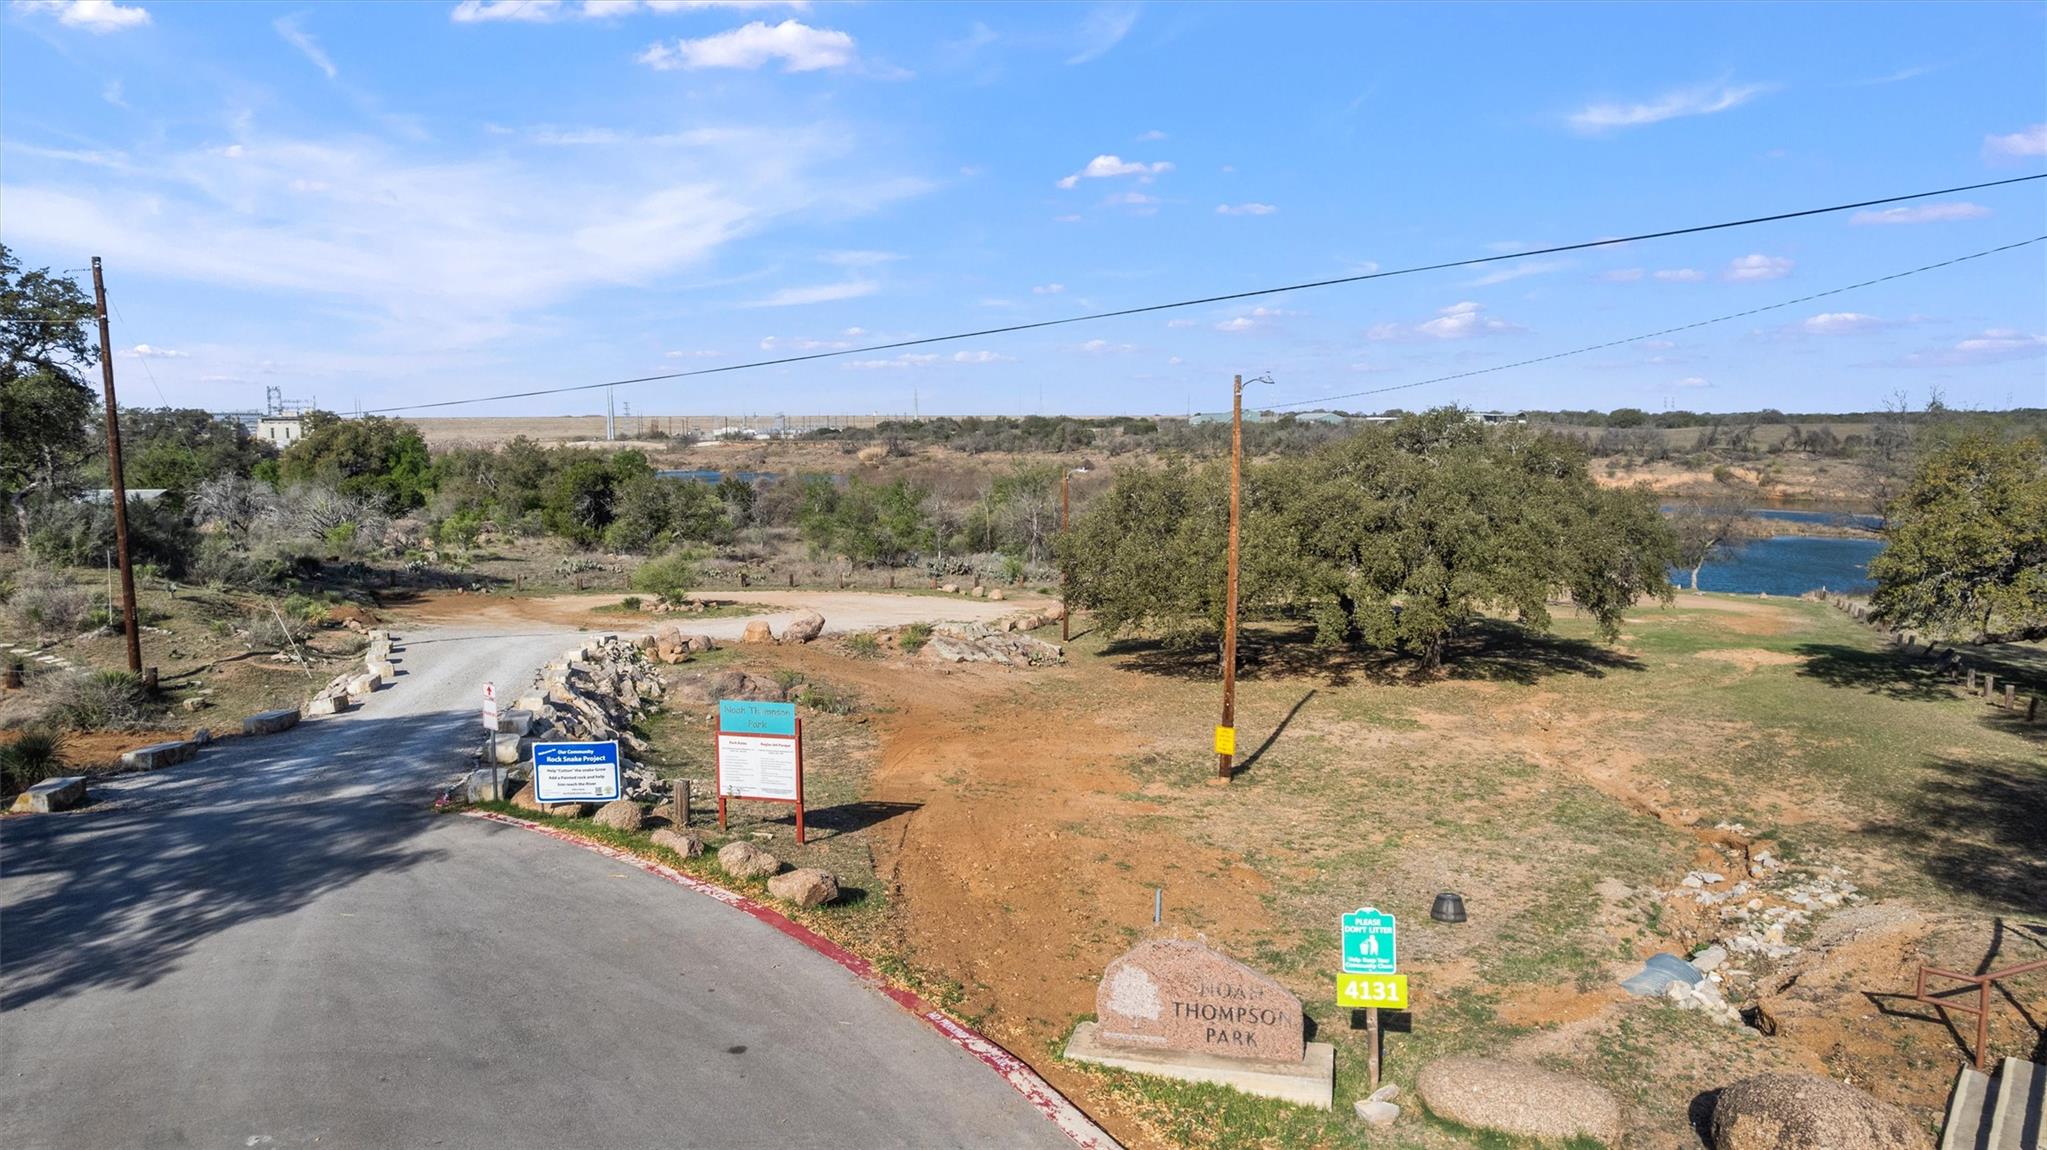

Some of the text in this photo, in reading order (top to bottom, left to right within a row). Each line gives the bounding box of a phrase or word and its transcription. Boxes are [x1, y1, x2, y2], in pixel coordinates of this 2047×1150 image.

[748, 720, 768, 728] Park
[583, 755, 606, 763] Project
[1355, 918, 1381, 926] PLEASE
[1369, 926, 1393, 934] LITTER
[1200, 983, 1264, 999] NOAH
[1344, 981, 1400, 1002] 4131
[1172, 1001, 1291, 1026] THOMPSON
[1206, 1027, 1258, 1047] PARK
